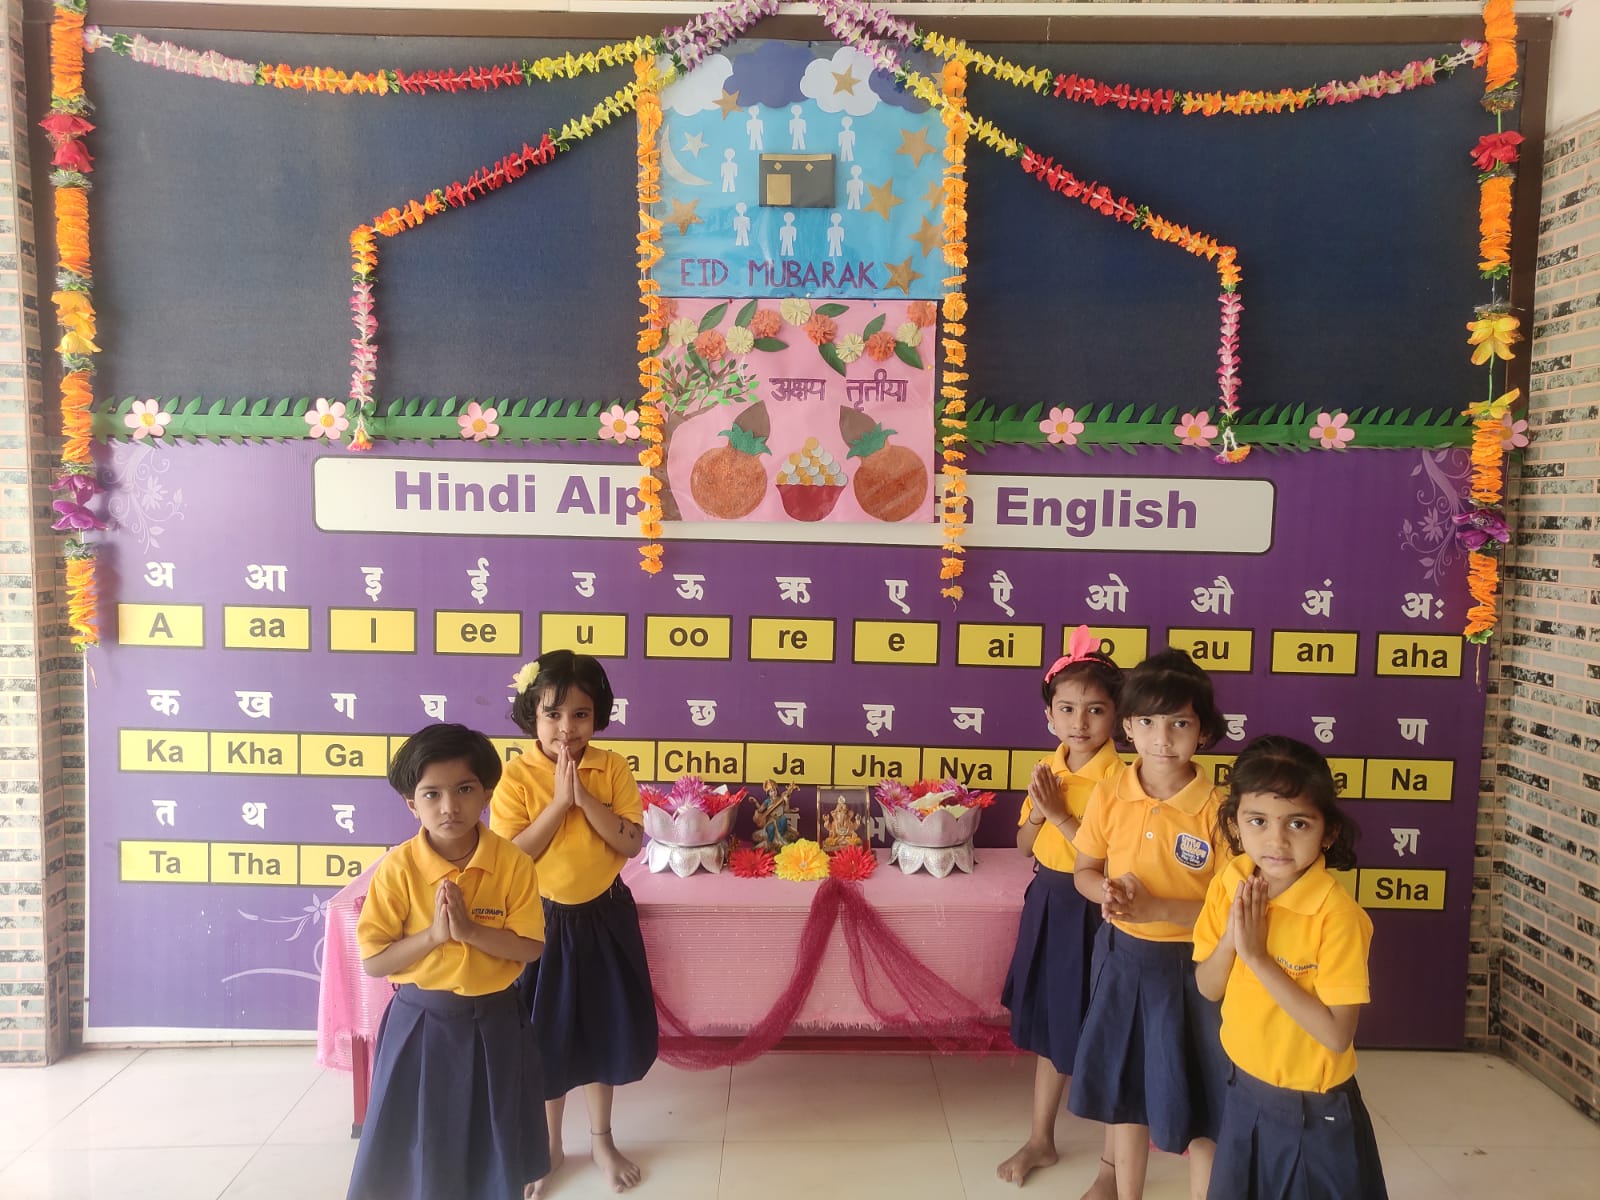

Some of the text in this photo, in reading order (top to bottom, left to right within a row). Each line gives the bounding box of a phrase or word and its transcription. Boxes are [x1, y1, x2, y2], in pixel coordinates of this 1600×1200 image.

[680, 258, 878, 289] EID MUBARAK
[846, 368, 909, 412] तृतीया
[394, 470, 536, 513] Hindi
[996, 486, 1197, 538] English
[143, 557, 1445, 620] अ आ इ ई उ ऊ ऋ ए ऐ ओ औ अं अः
[148, 612, 174, 639] A
[249, 617, 286, 638] aa
[460, 622, 497, 643] ee
[576, 625, 594, 645] u
[669, 627, 709, 647] oo
[778, 629, 808, 650] re
[887, 632, 906, 652] e
[987, 632, 1015, 659] ai
[1191, 640, 1230, 661] au
[1296, 642, 1334, 663] an
[1391, 642, 1448, 669] aha
[146, 689, 182, 717] क
[234, 690, 274, 719] ख
[330, 692, 358, 720] ग
[419, 694, 448, 722] घ
[686, 699, 718, 727] छ
[773, 701, 807, 729] ज
[862, 703, 896, 738] झ
[949, 706, 985, 735] ञ
[1223, 713, 1248, 741] ड
[1310, 716, 1337, 744] ढ
[1396, 717, 1429, 746] ण
[146, 738, 184, 763] Ka
[227, 741, 283, 766] Kha
[325, 743, 364, 768] Ga
[664, 749, 738, 775] Chha
[772, 752, 805, 776] Ja
[851, 754, 903, 779] Jha
[939, 756, 993, 786] Nya
[1391, 767, 1428, 792] Na
[151, 799, 178, 827] त
[241, 801, 268, 830] थ
[331, 804, 356, 834] द
[1390, 827, 1421, 857] श
[148, 850, 1429, 901] Ta Tha Da Sha
